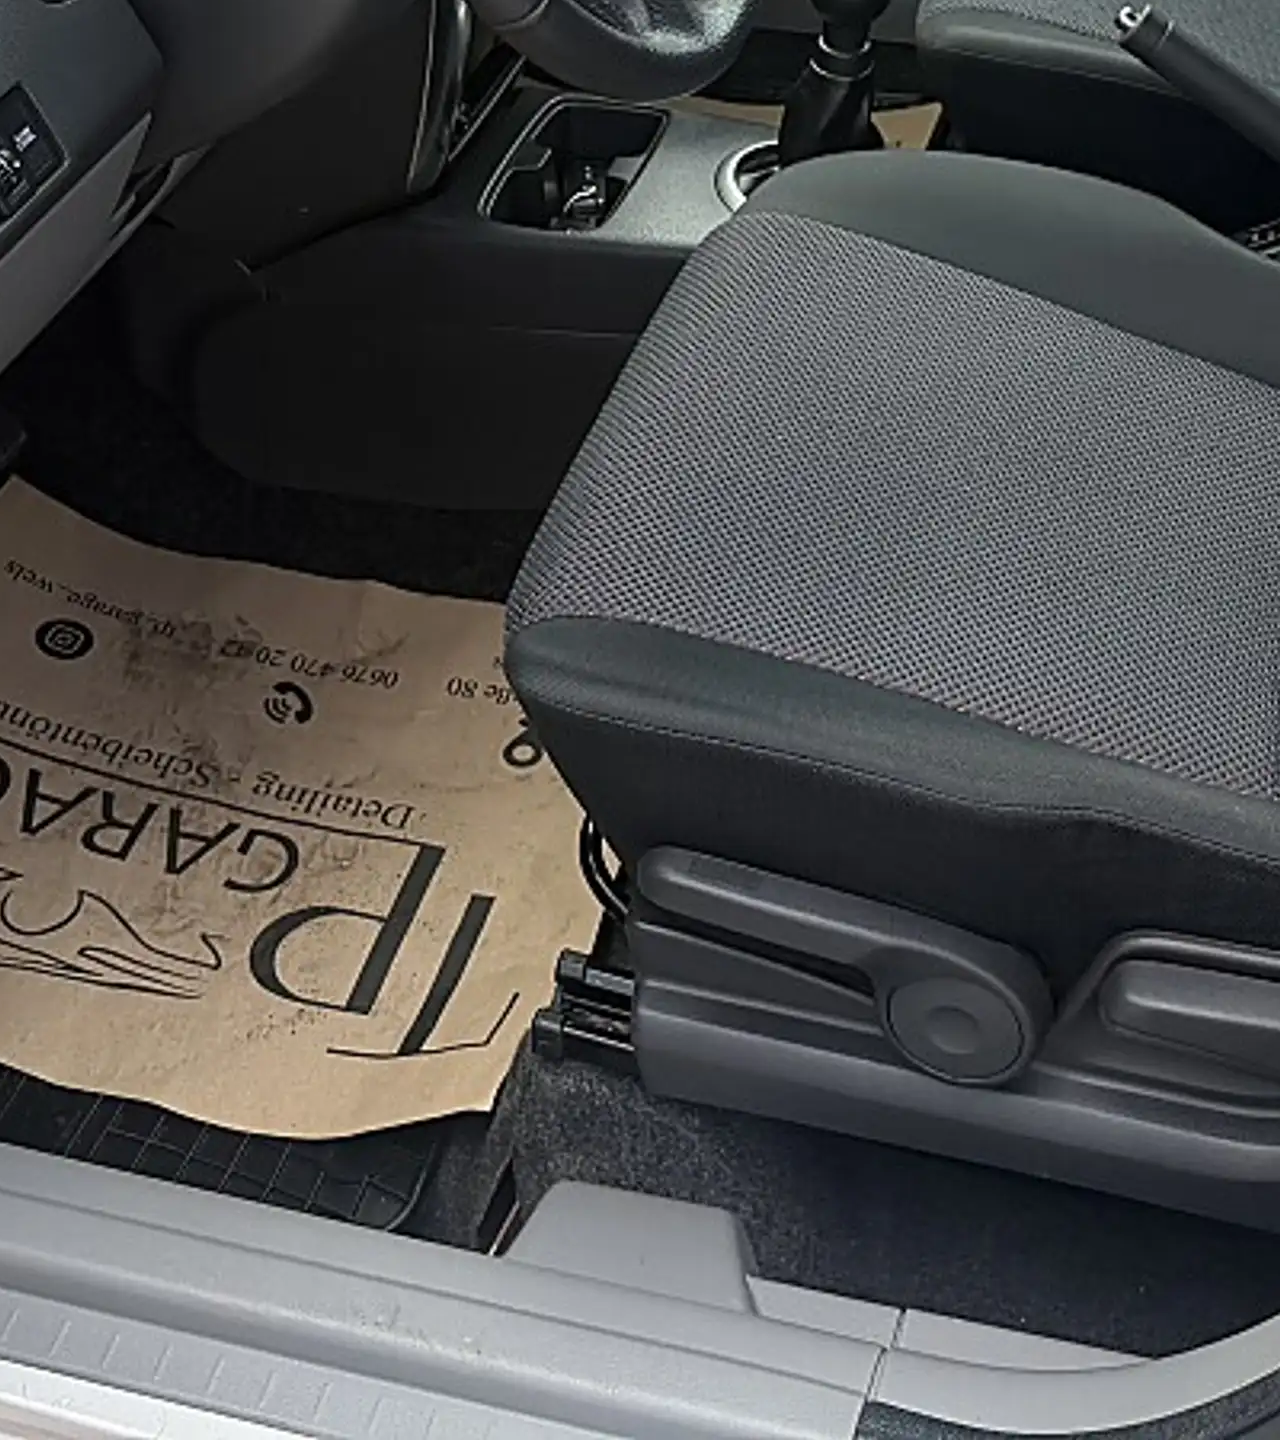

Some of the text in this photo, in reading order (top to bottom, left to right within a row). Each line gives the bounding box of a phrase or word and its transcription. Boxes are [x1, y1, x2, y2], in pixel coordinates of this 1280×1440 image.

[254, 646, 284, 666] 20
[291, 654, 336, 677] 470
[341, 667, 400, 689] 0676
[252, 769, 417, 832] Detailing
